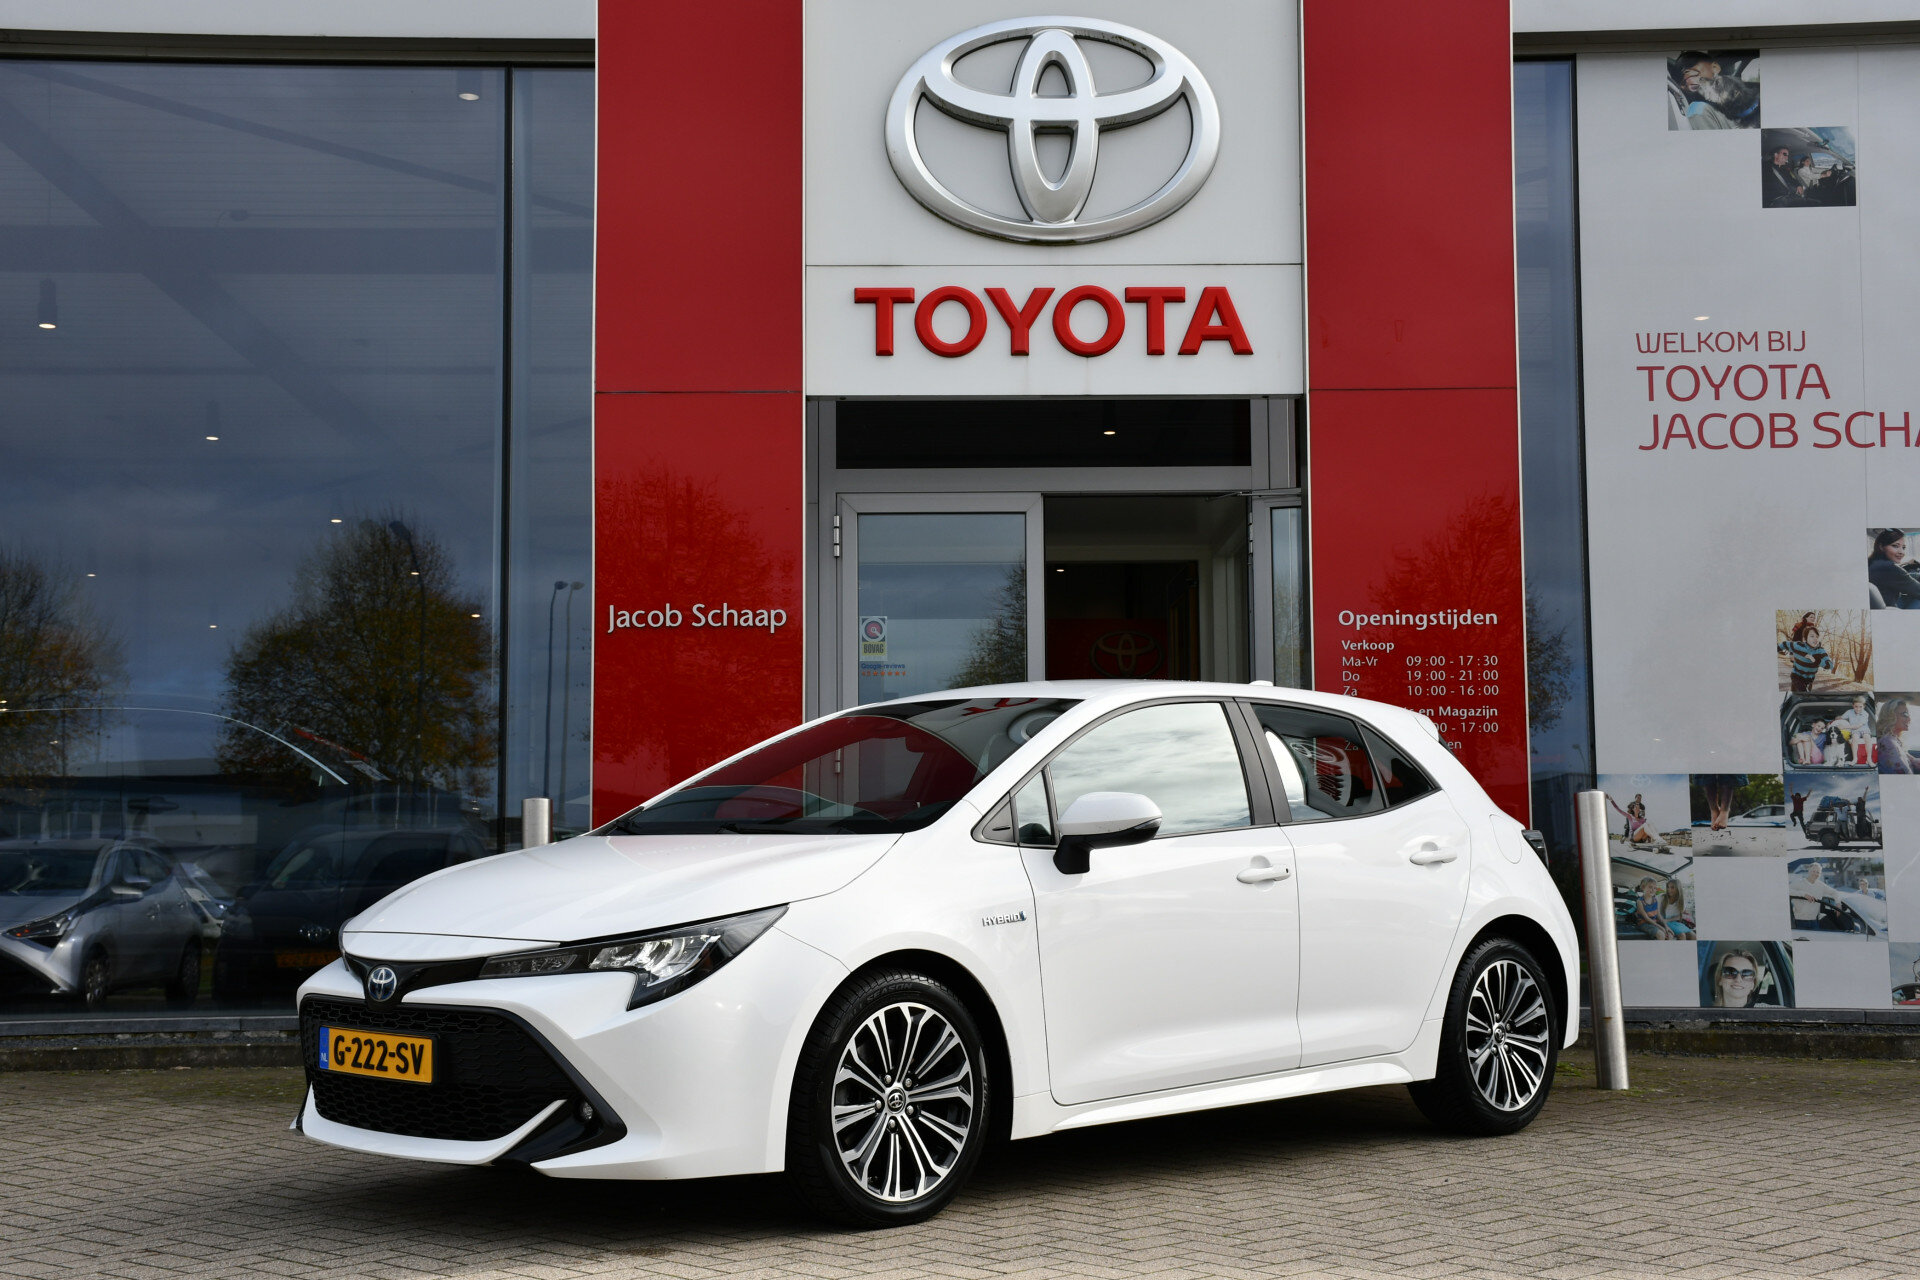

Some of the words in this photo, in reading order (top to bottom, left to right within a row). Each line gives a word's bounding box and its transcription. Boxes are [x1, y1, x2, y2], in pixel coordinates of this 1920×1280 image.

[854, 285, 1254, 358] TOYOTA
[1635, 331, 1759, 353] WELKOM
[1767, 330, 1806, 352] BIJ
[1636, 363, 1831, 402] TOYOTA
[1638, 412, 1799, 451] JACOB
[607, 603, 683, 634] Jacob
[691, 602, 787, 634] Schaap
[1338, 608, 1498, 630] Openingstijden
[863, 643, 884, 654] BOVAG
[1341, 640, 1395, 653] Verkoop
[1342, 656, 1379, 667] Ma-Vr
[1342, 670, 1360, 682] Do
[1342, 685, 1358, 697] Za
[1418, 708, 1435, 717] en
[1438, 705, 1498, 720] Magazijn
[981, 913, 1020, 927] HYBRID
[320, 1052, 328, 1062] NL
[333, 1035, 424, 1075] G-222-SV
